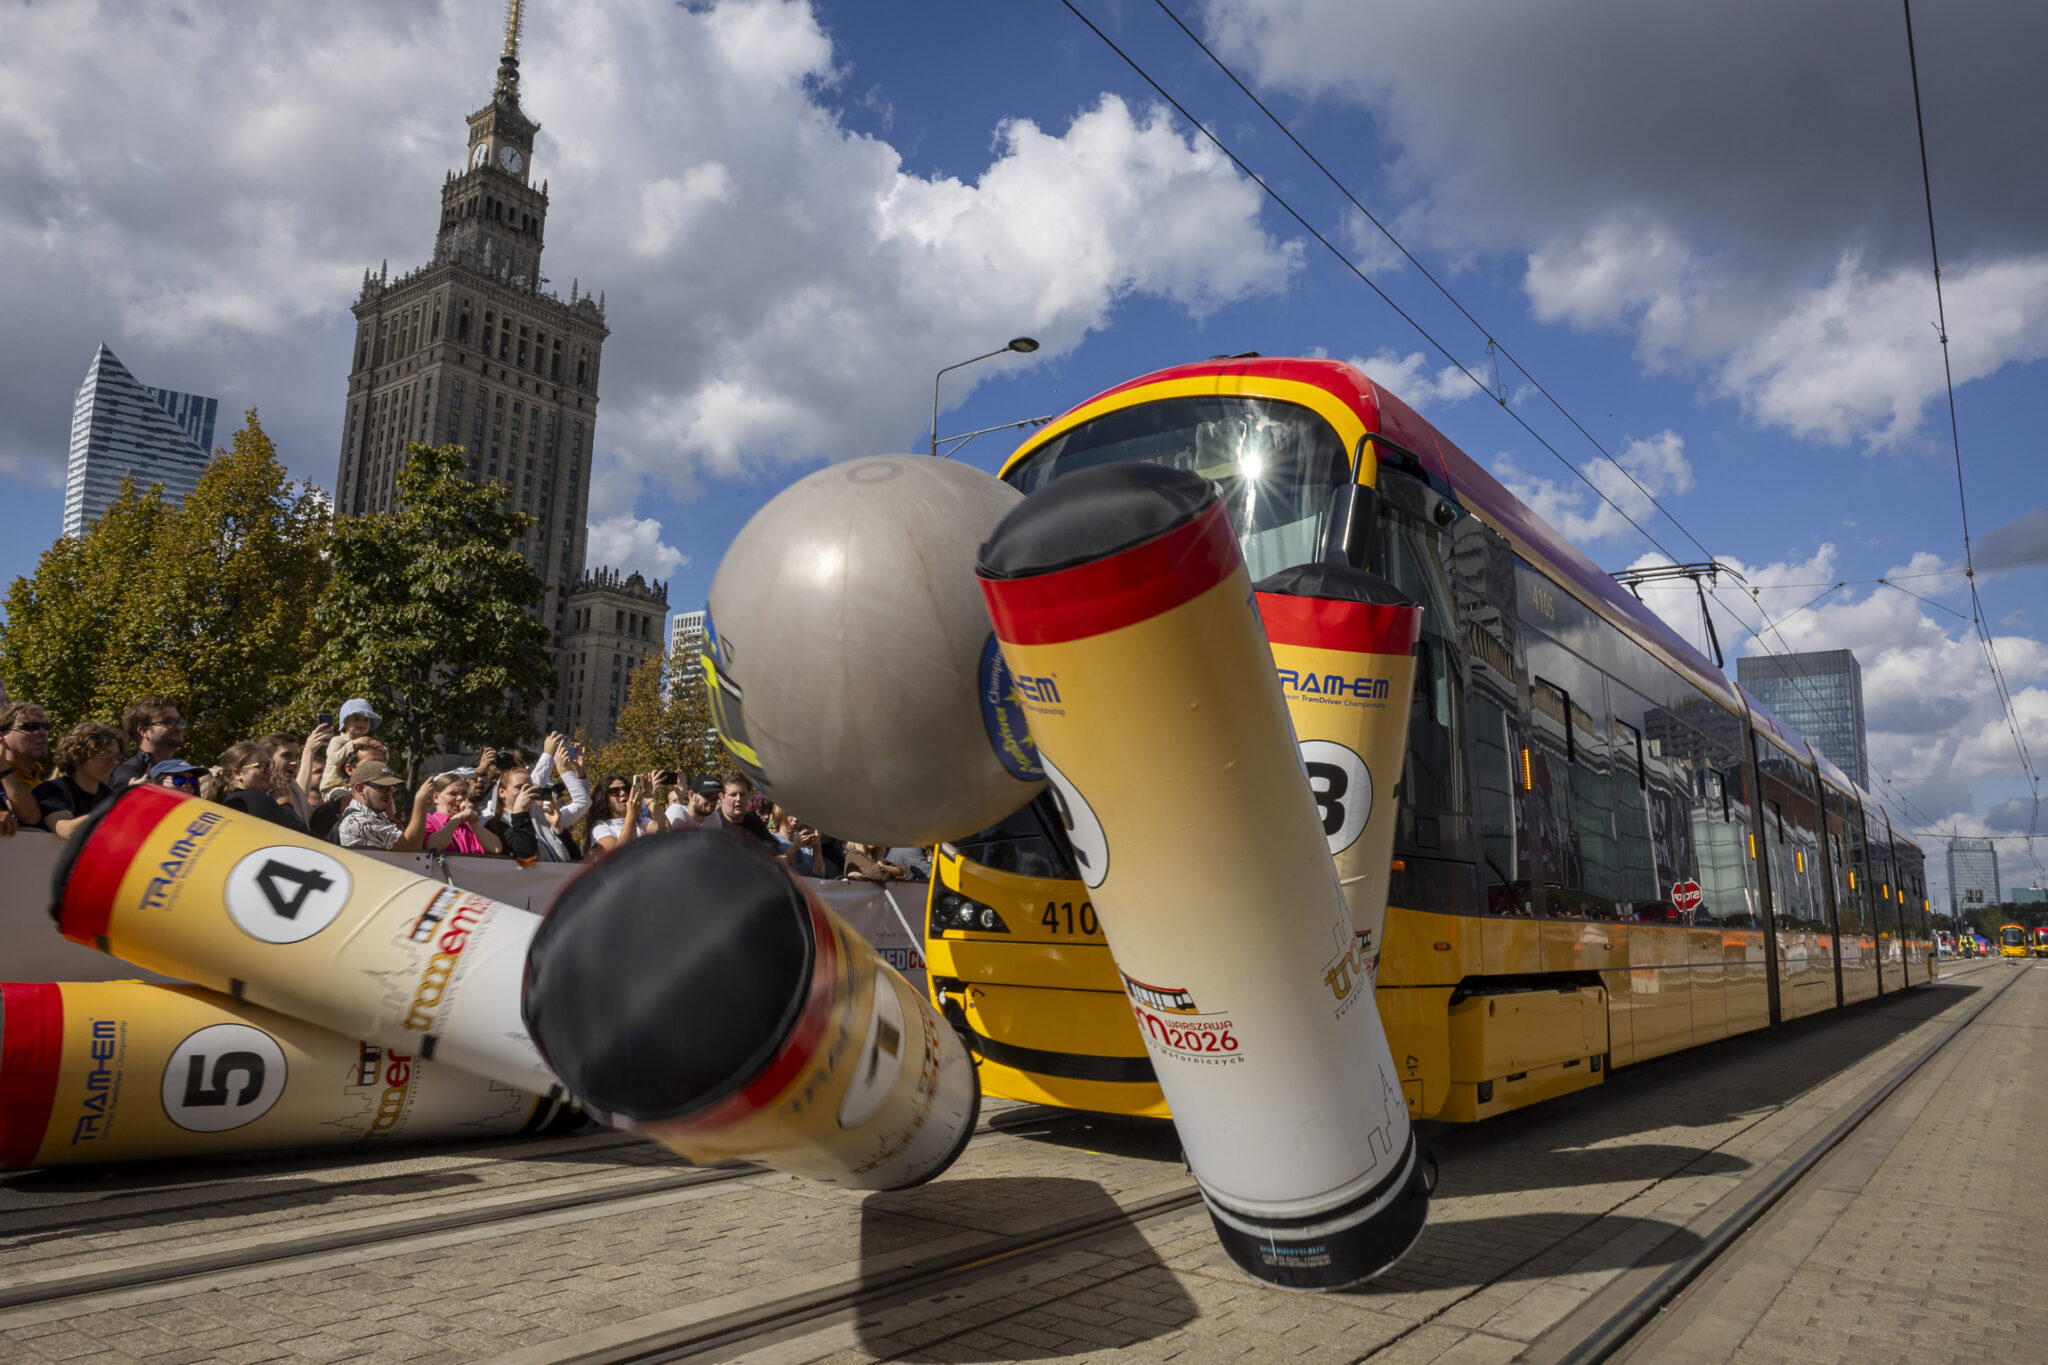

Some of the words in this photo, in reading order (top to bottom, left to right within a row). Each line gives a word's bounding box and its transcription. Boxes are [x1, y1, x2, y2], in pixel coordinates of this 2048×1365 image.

[1277, 668, 1389, 699] RAM-EM
[1301, 694, 1342, 706] TramDriver
[255, 859, 336, 921] 4
[1041, 901, 1104, 935] 410
[1165, 1020, 1233, 1031] WARSZAWA
[1169, 1030, 1239, 1052] 2026
[181, 1051, 266, 1108] 5
